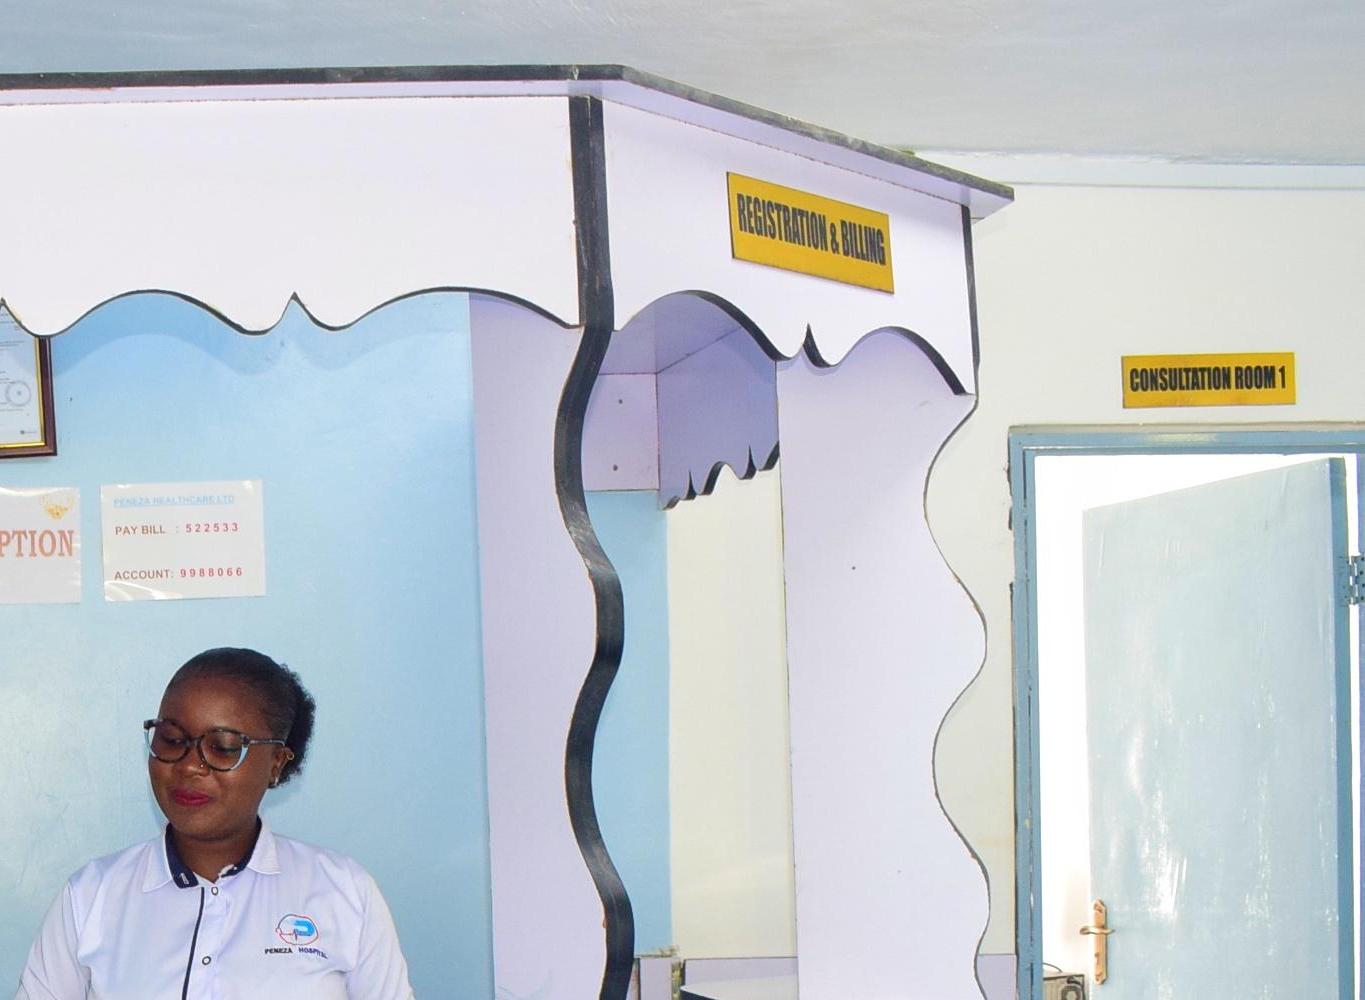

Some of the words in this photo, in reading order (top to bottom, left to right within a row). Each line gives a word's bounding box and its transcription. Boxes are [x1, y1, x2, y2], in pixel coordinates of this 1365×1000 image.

[736, 193, 828, 252] REGISTRATION
[829, 222, 840, 254] &
[840, 219, 886, 266] BILLING
[1129, 366, 1232, 392] CONSULTATION
[1234, 365, 1276, 390] ROOM
[1278, 365, 1286, 389] 1
[114, 525, 138, 536] PAY
[141, 524, 167, 535] BILL
[264, 947, 294, 955] PENEZA
